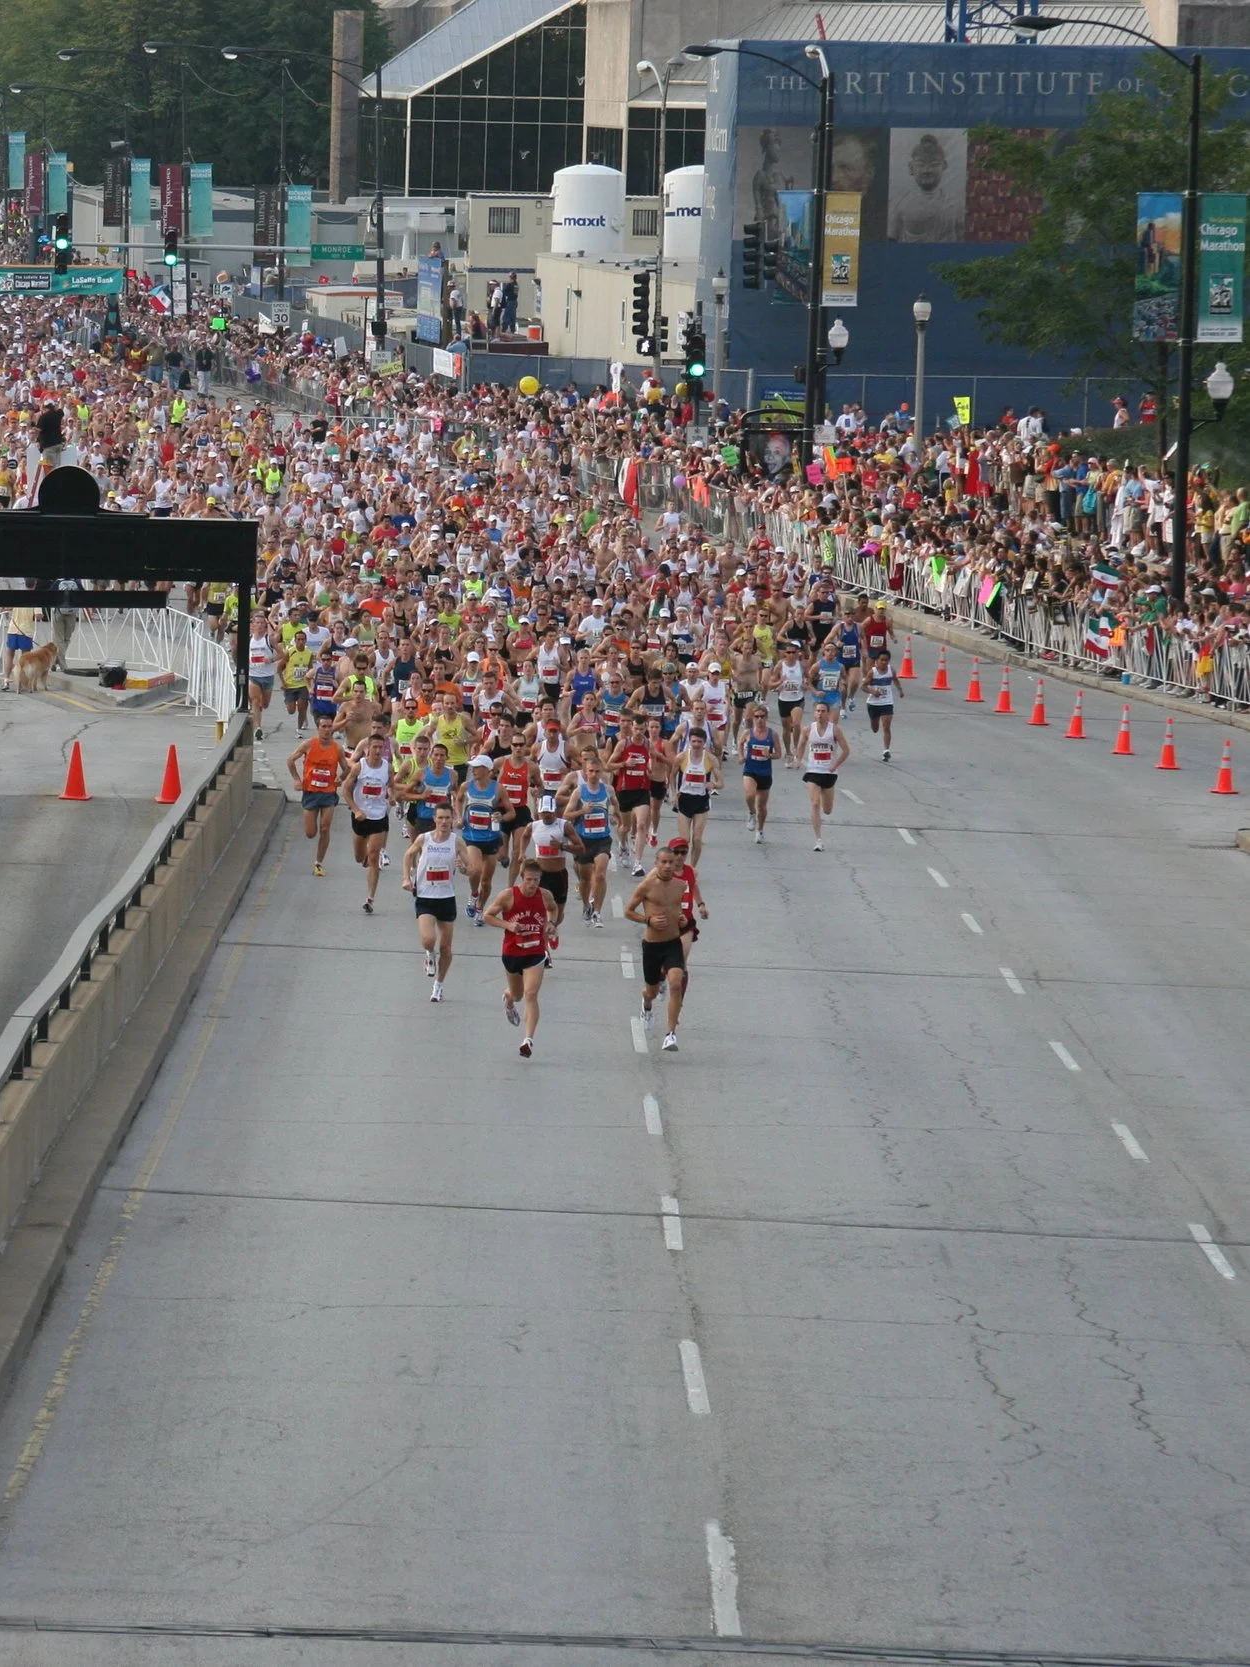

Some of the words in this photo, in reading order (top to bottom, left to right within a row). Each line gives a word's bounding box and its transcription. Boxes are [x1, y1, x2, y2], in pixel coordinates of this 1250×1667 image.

[765, 75, 809, 90] THE
[832, 71, 893, 96] RT
[907, 71, 1104, 96] INSTITUTE
[1117, 77, 1145, 93] OF
[255, 190, 268, 234] Thursday
[563, 215, 607, 227] maxit
[825, 214, 855, 226] Chicago
[824, 227, 860, 236] Marathon
[1200, 223, 1238, 238] Chicago
[1200, 239, 1245, 252] Marathon
[71, 276, 96, 284] LaSalle
[97, 276, 114, 284] Bank
[274, 314, 288, 323] 30
